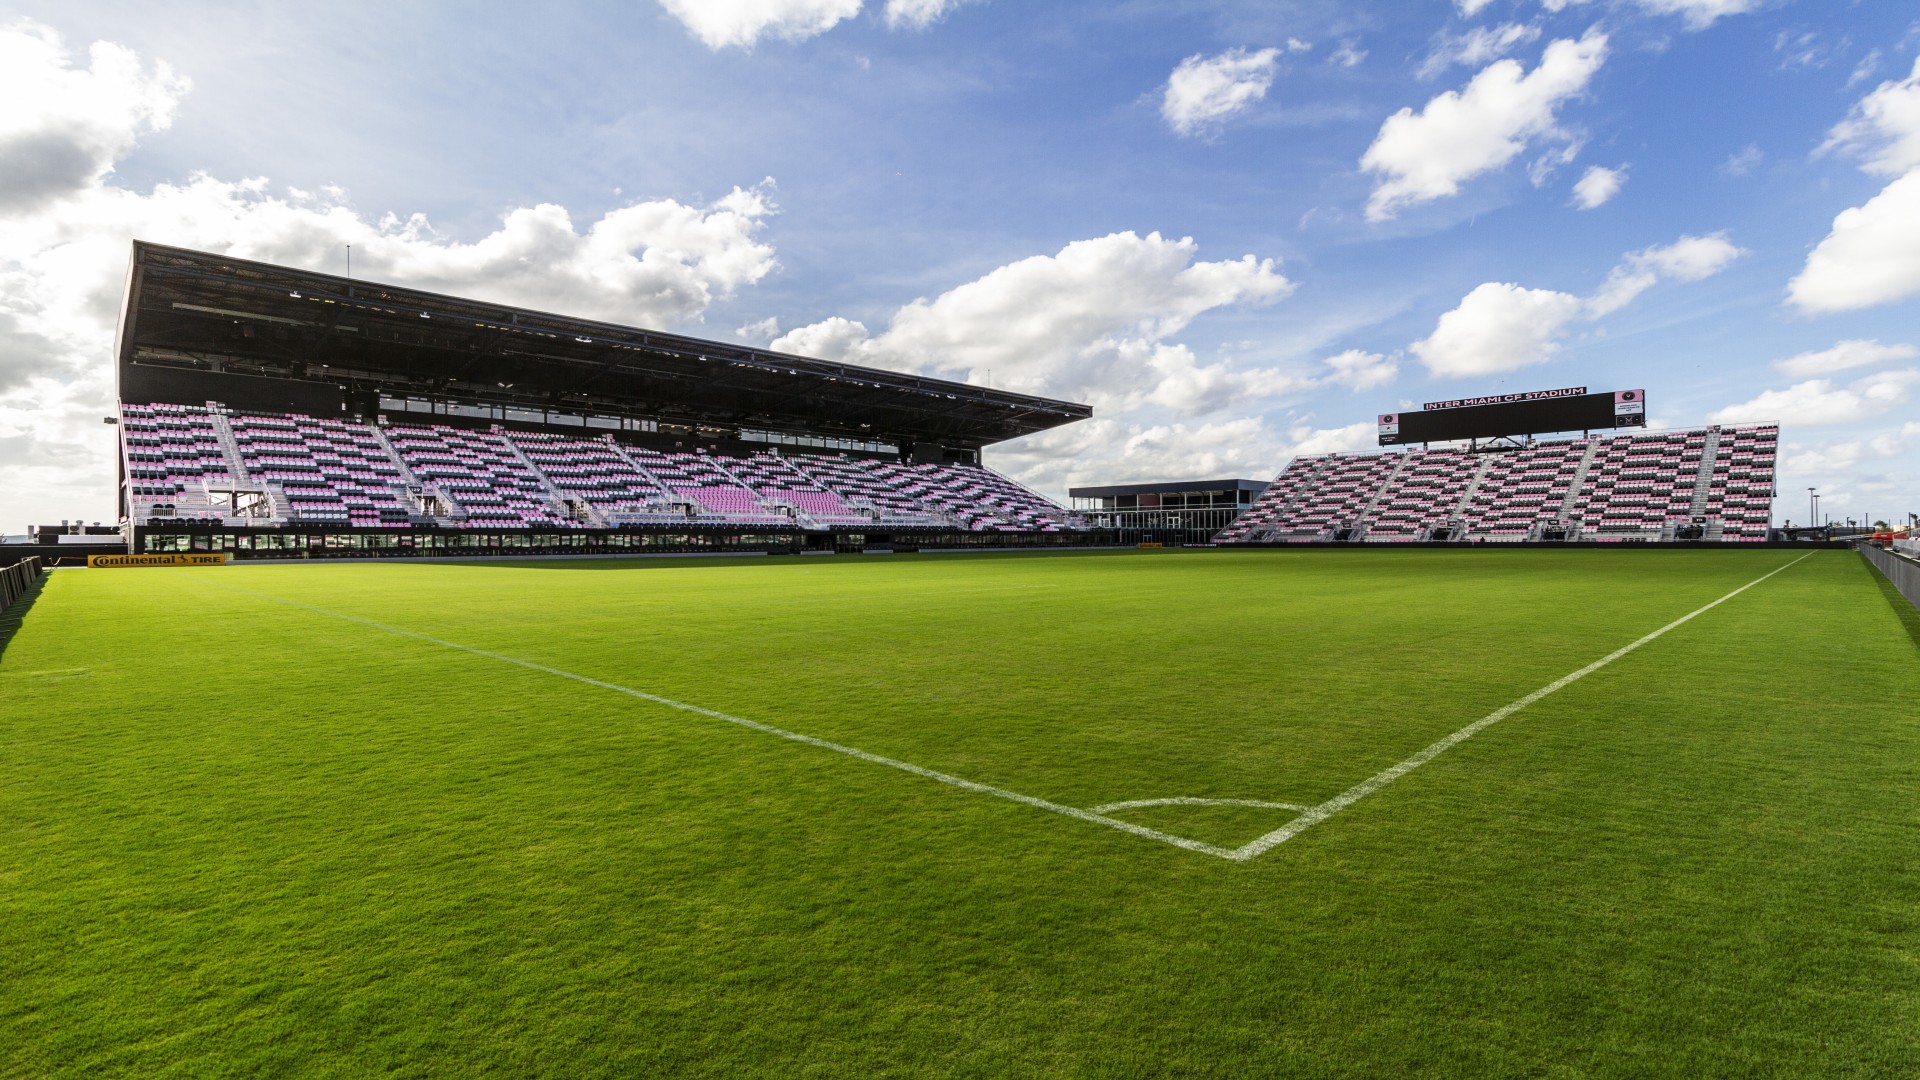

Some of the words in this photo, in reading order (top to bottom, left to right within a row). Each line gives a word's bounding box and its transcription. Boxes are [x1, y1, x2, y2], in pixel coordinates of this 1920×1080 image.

[1425, 400, 1460, 409] INTER
[1464, 396, 1501, 405] MIAMI
[1504, 394, 1521, 402] CF
[1525, 388, 1583, 399] STADIUM
[93, 555, 175, 567] Continental
